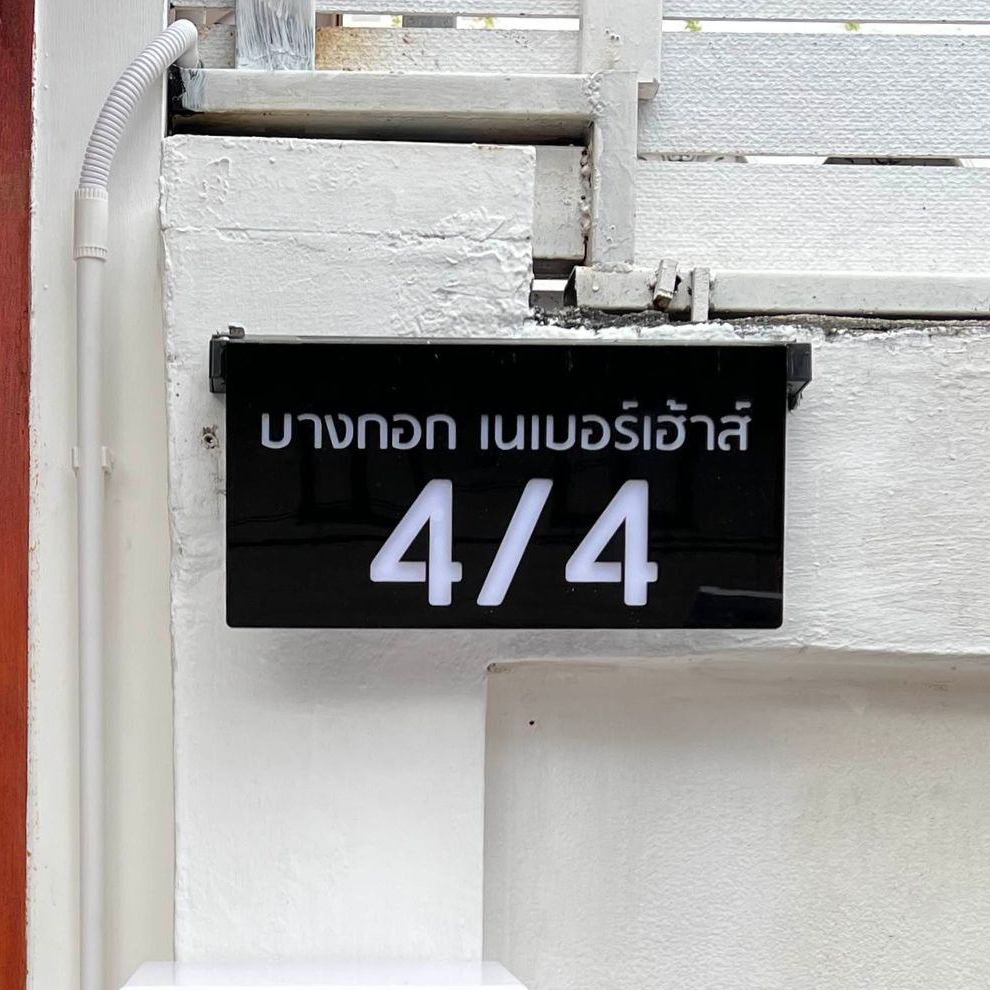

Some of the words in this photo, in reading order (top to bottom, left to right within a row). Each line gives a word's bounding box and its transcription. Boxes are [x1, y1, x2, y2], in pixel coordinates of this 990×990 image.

[260, 412, 457, 451] บางกอก
[480, 398, 753, 451] เนเบอร์เฮ้าส์
[369, 478, 659, 607] 4/4
